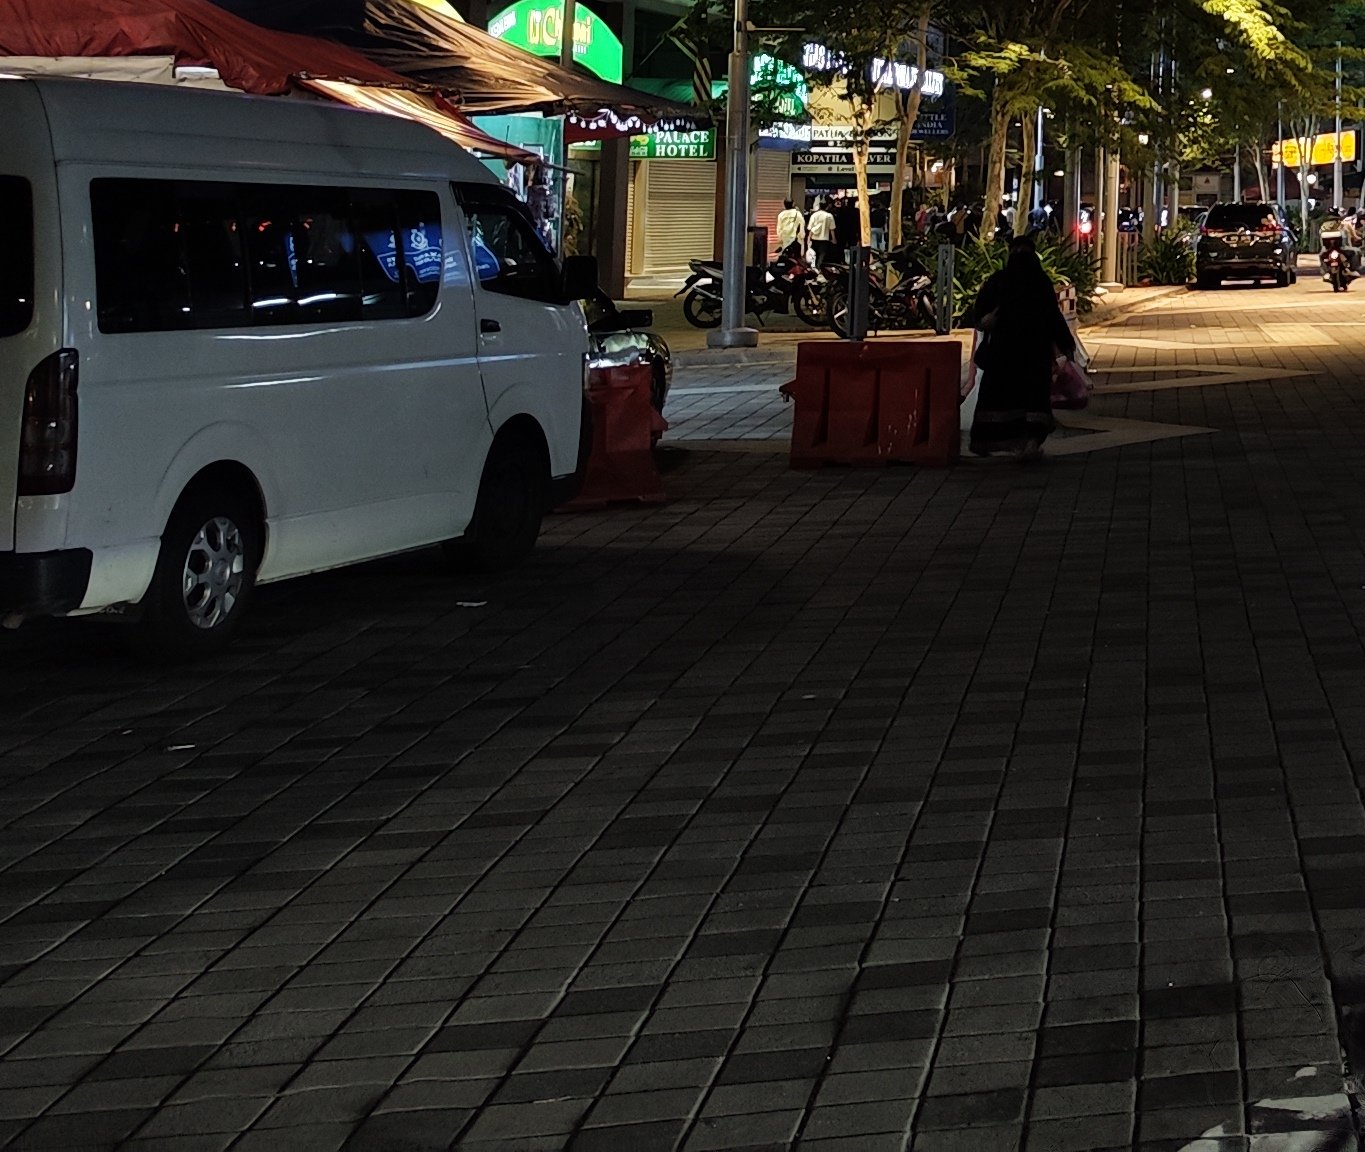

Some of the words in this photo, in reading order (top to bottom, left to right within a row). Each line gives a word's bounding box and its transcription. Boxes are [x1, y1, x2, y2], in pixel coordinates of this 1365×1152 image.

[655, 130, 709, 143] PALACE
[655, 144, 708, 157] HOTEL
[796, 154, 847, 163] KOPATHA
